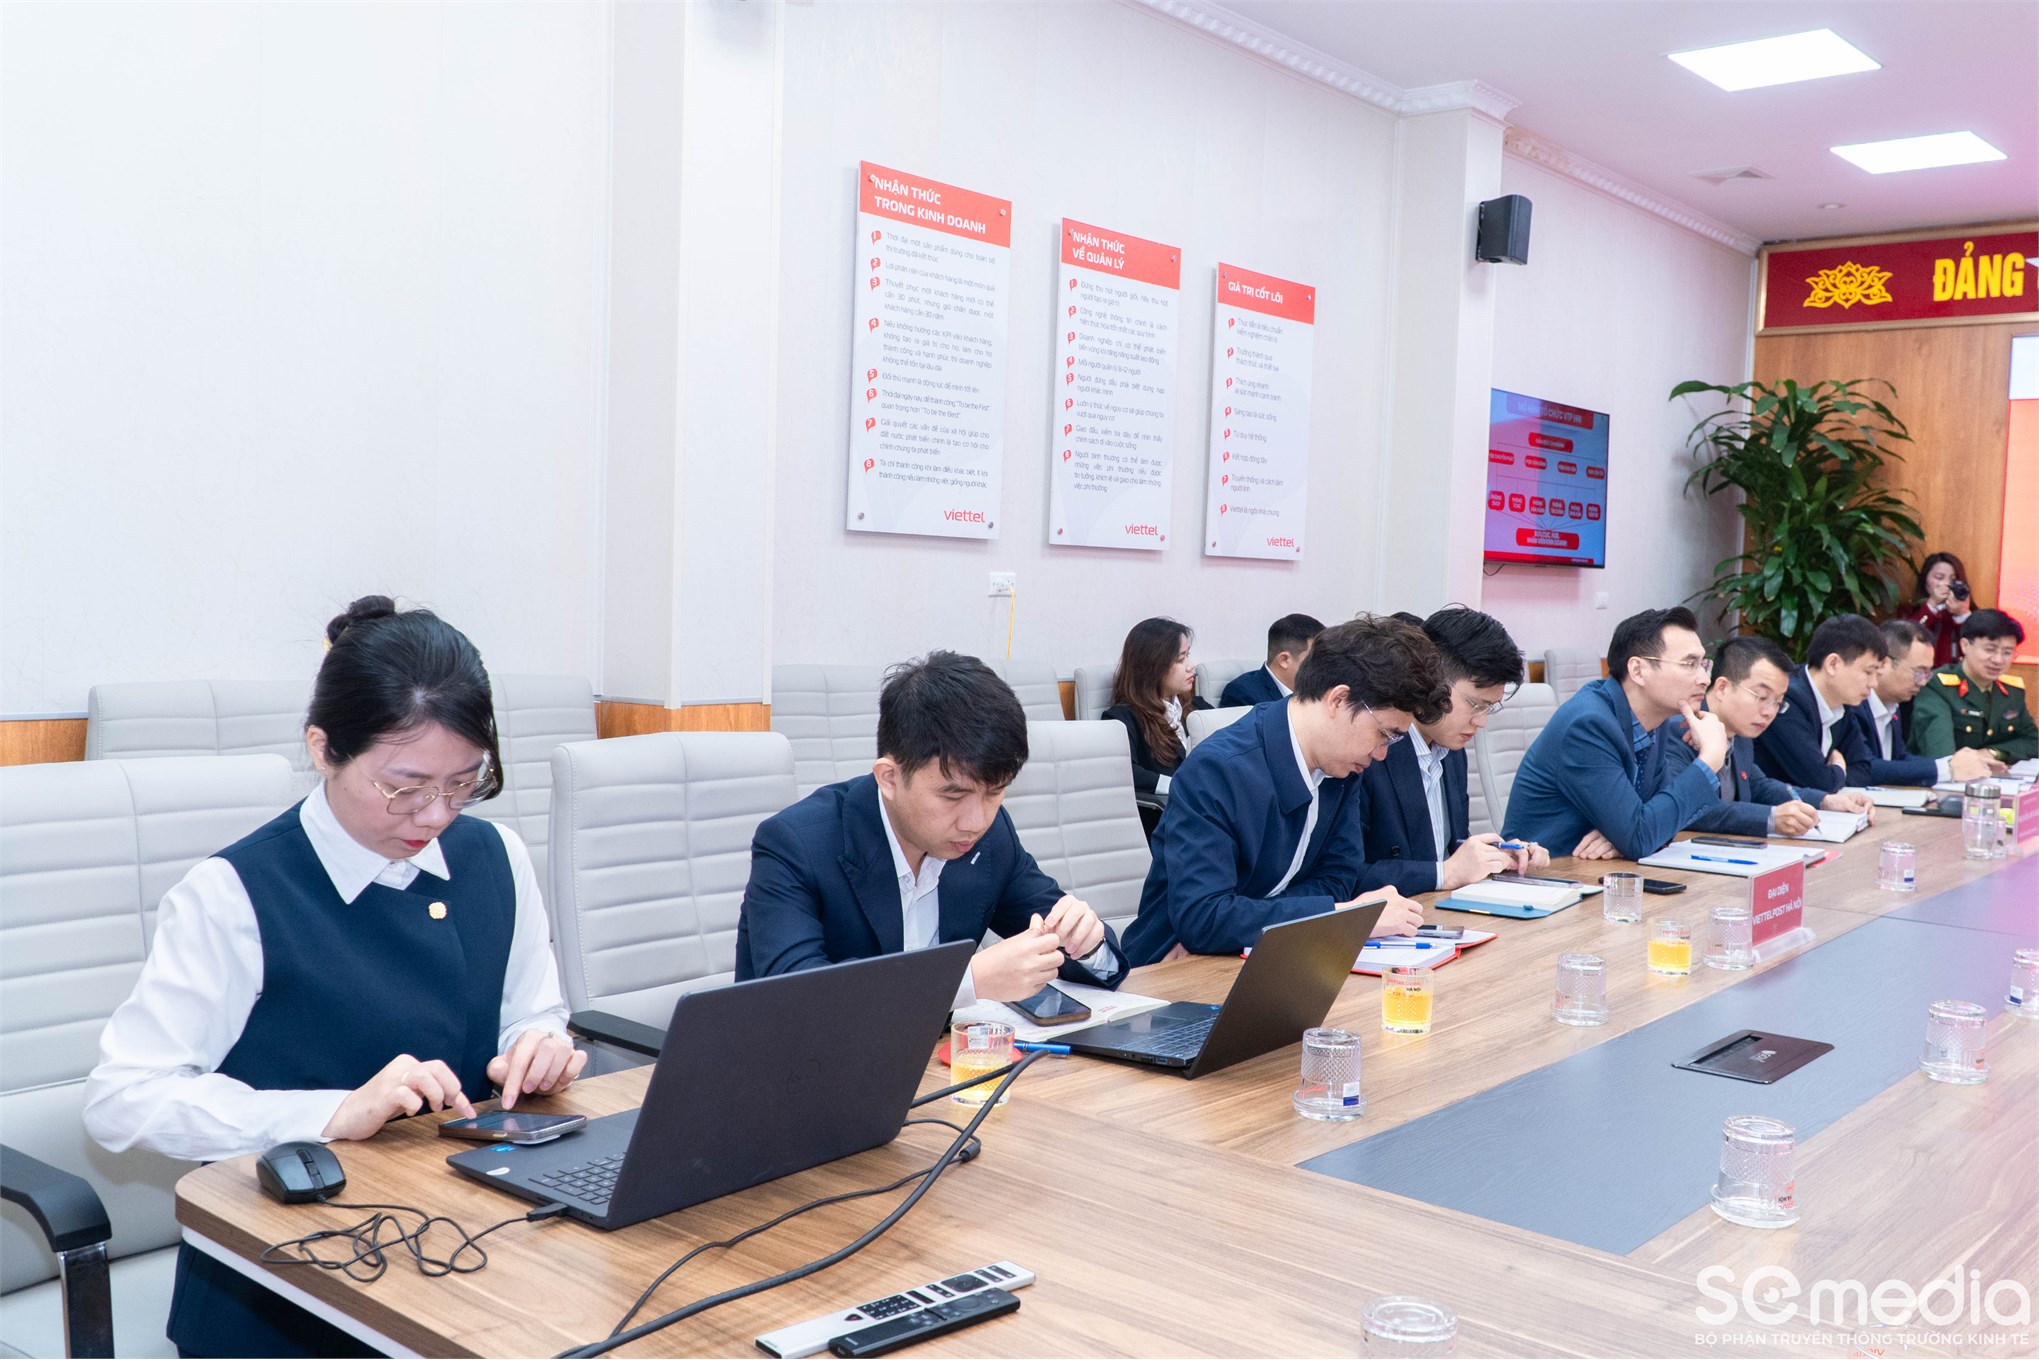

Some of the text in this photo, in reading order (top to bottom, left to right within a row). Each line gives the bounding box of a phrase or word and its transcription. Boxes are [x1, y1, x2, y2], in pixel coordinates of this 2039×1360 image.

[875, 178, 941, 205] NHẬN THỨC
[874, 196, 986, 234] TRONG KINH DOANH
[1073, 230, 1125, 254] NHẬN THỨC
[1072, 246, 1125, 270] VỀ QUẢN LÝ
[1933, 241, 2025, 301] ĐẢNG
[1228, 281, 1240, 293] GIÁ
[1242, 285, 1254, 298] TRỊ
[1255, 286, 1270, 300] CỐT
[943, 508, 985, 523] viettel
[1124, 523, 1158, 536] viettel
[1266, 536, 1294, 547] viettel
[1768, 882, 1789, 899] ĐẠI DIỆN
[1752, 897, 1802, 925] VIETTELPOST HÀ NỘI
